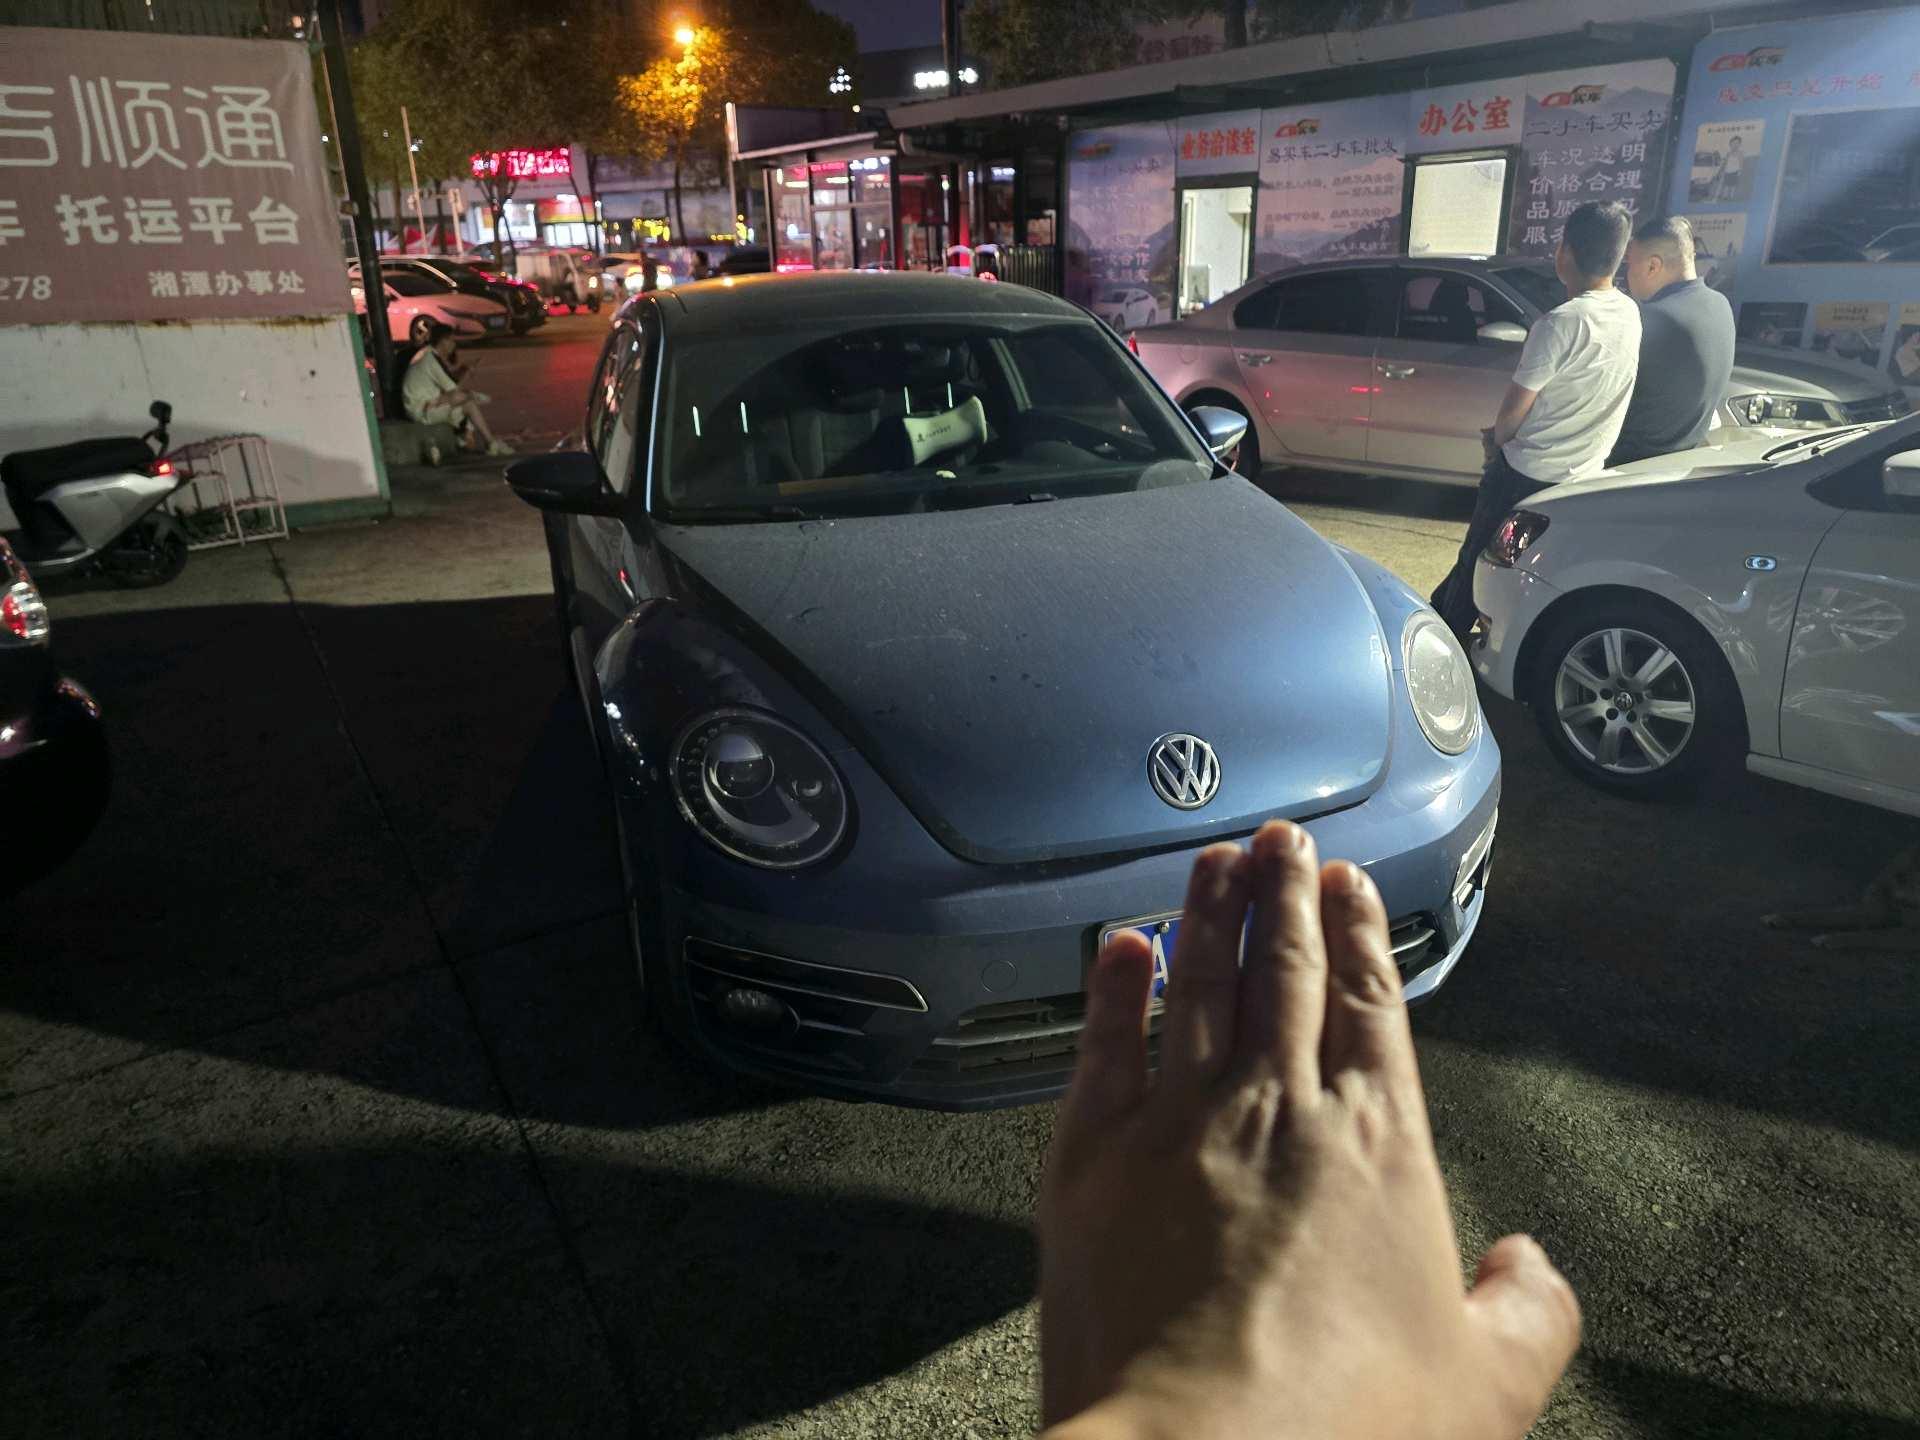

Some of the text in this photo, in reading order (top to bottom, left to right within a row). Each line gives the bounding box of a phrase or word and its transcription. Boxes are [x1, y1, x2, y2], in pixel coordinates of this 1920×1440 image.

[1419, 96, 1511, 136] 办公室
[1181, 127, 1256, 160] 业务洽谈室
[1528, 169, 1643, 195] 价格合理
[148, 269, 305, 298] 湘潭办事处
